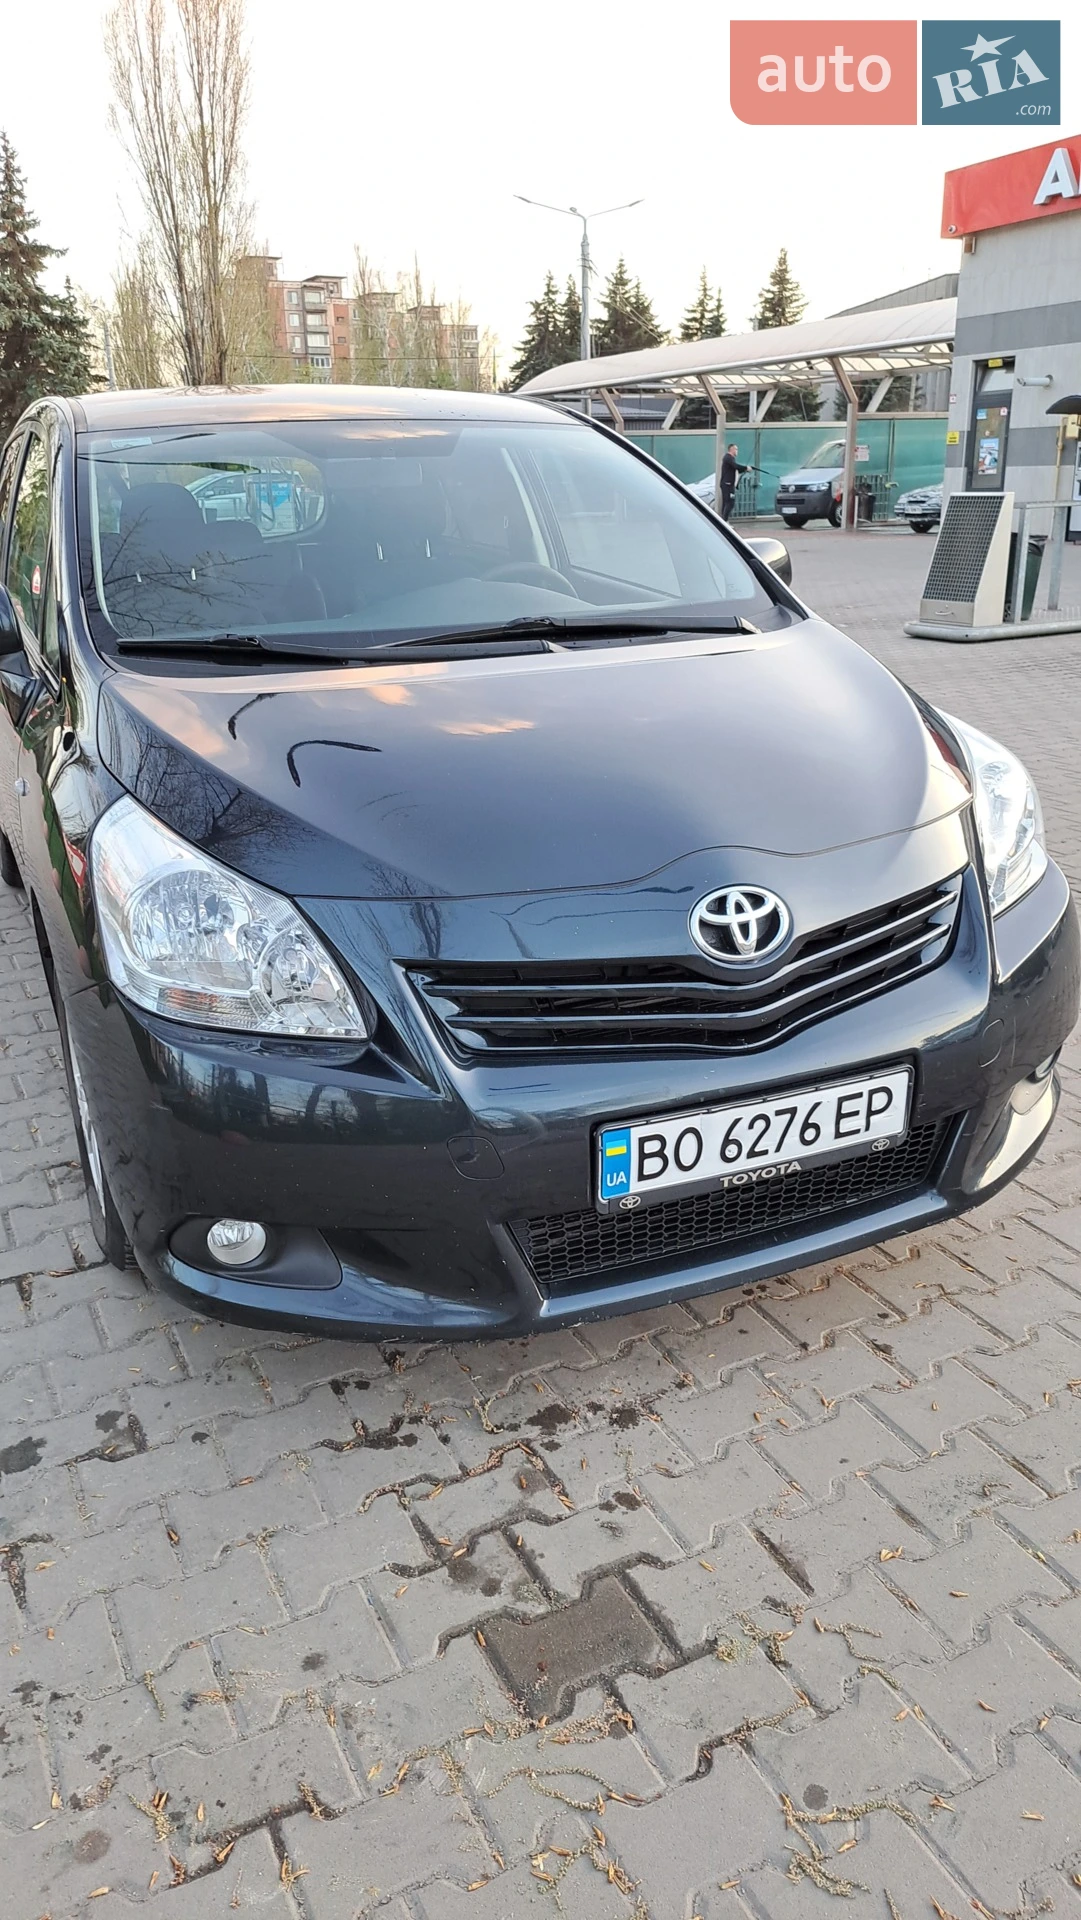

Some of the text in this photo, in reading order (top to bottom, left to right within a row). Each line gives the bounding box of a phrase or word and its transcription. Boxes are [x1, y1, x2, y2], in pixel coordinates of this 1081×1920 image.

[1032, 147, 1081, 206] A
[637, 1085, 893, 1182] BO 6276 EP
[606, 1172, 627, 1187] UA
[720, 1160, 803, 1188] TOYOTA
